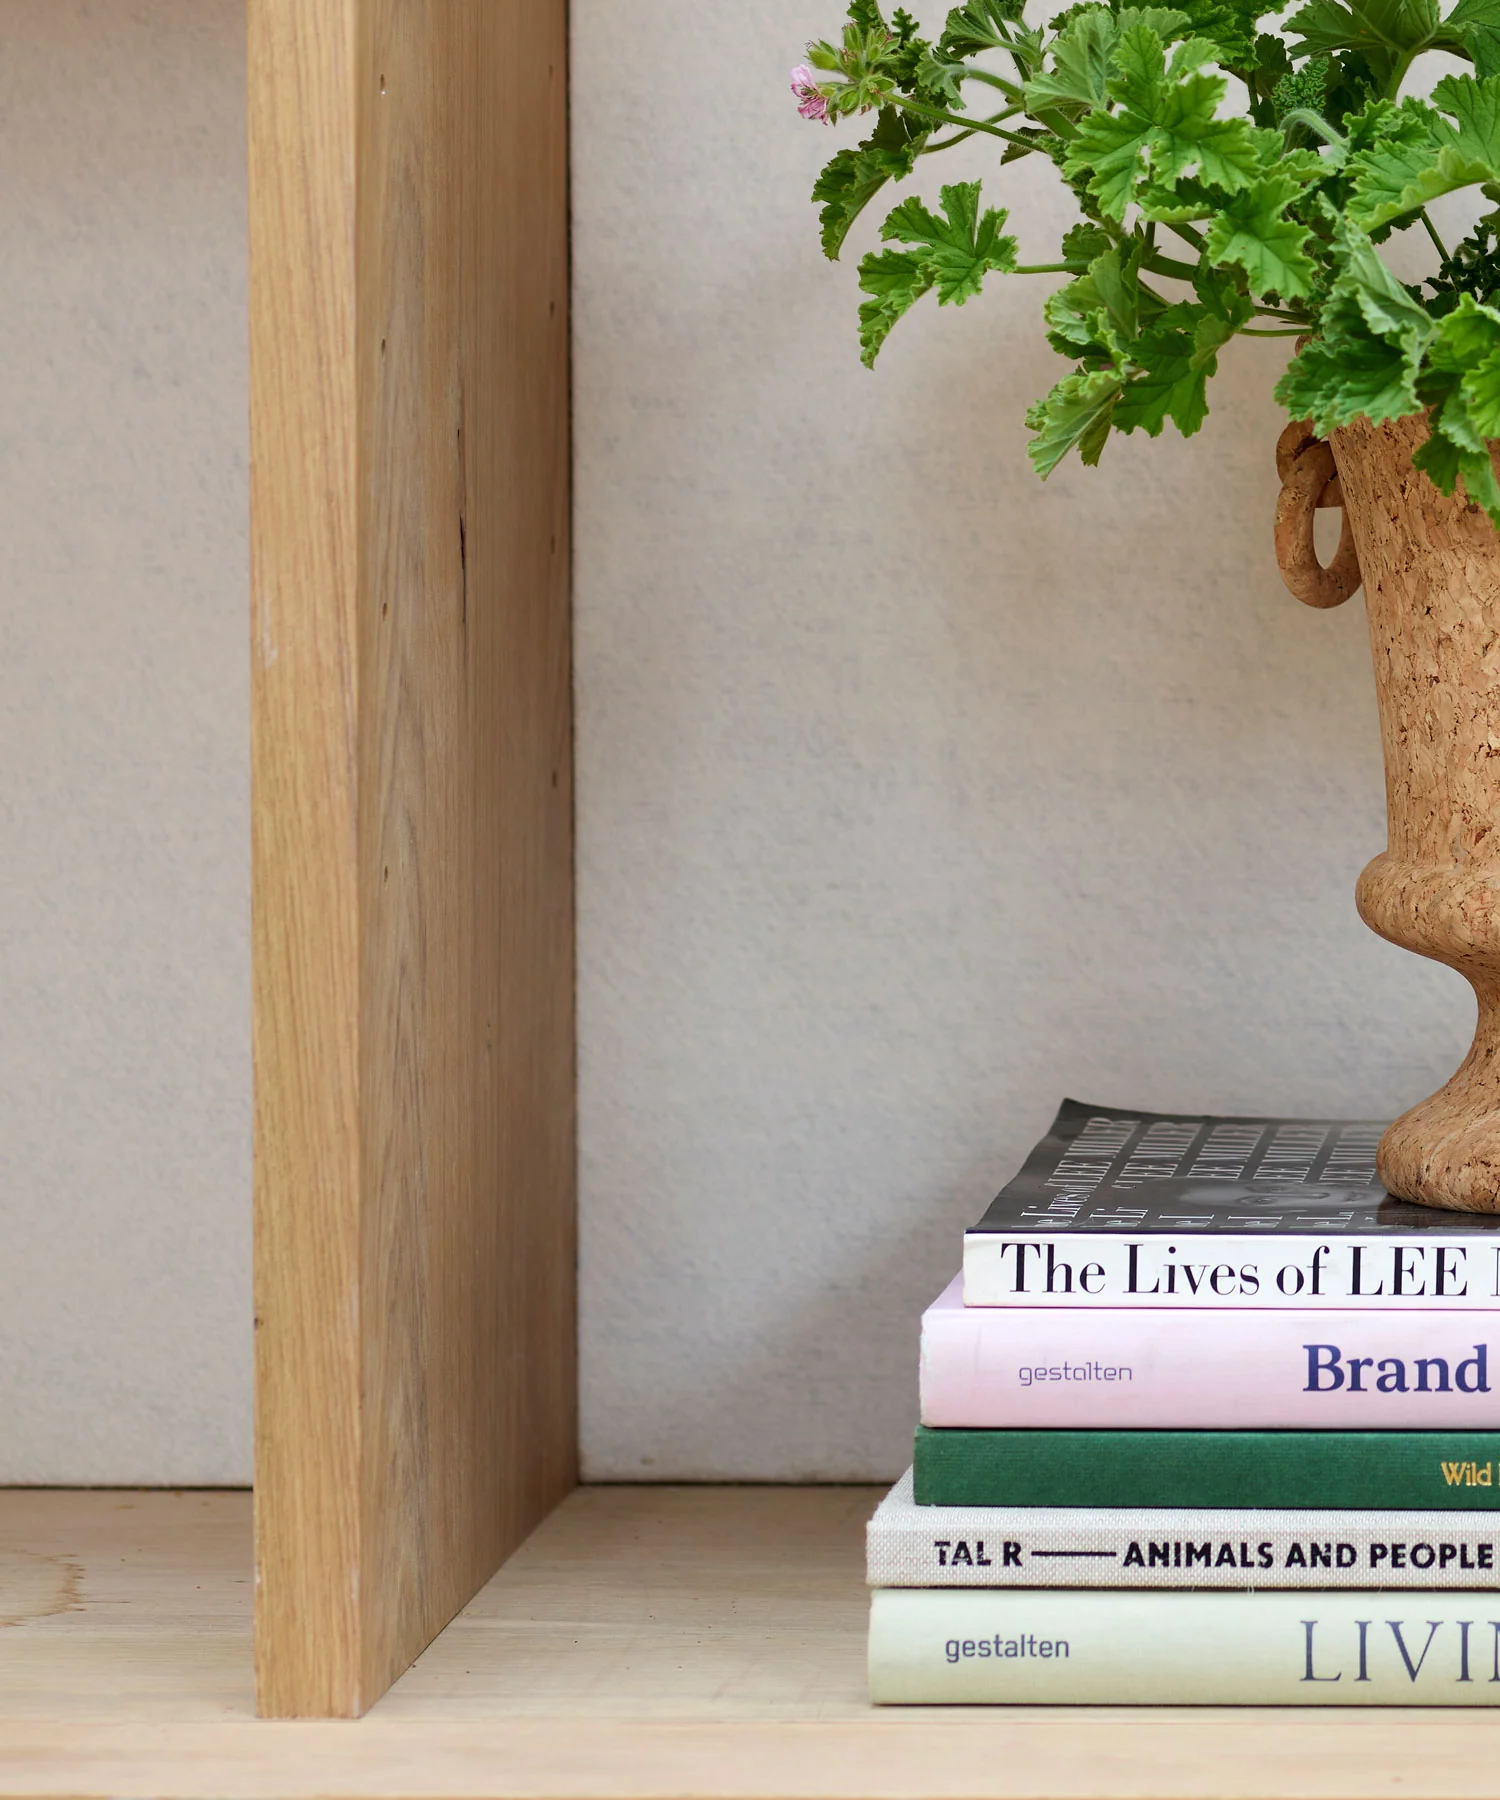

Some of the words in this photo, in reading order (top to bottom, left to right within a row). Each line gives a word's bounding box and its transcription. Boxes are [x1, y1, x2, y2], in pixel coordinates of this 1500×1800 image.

[1001, 1244, 1106, 1294] The
[1123, 1244, 1259, 1297] Lives
[1276, 1245, 1330, 1296] of
[1347, 1246, 1468, 1296] LEE
[1019, 1362, 1132, 1386] gestalten
[1302, 1343, 1490, 1394] Brand
[1440, 1462, 1492, 1486] Wild
[934, 1540, 992, 1567] TAL
[1122, 1541, 1274, 1569] ANIMALS
[1284, 1541, 1357, 1569] AND
[1369, 1542, 1494, 1570] PEOPLE
[945, 1636, 1070, 1663] gestalten
